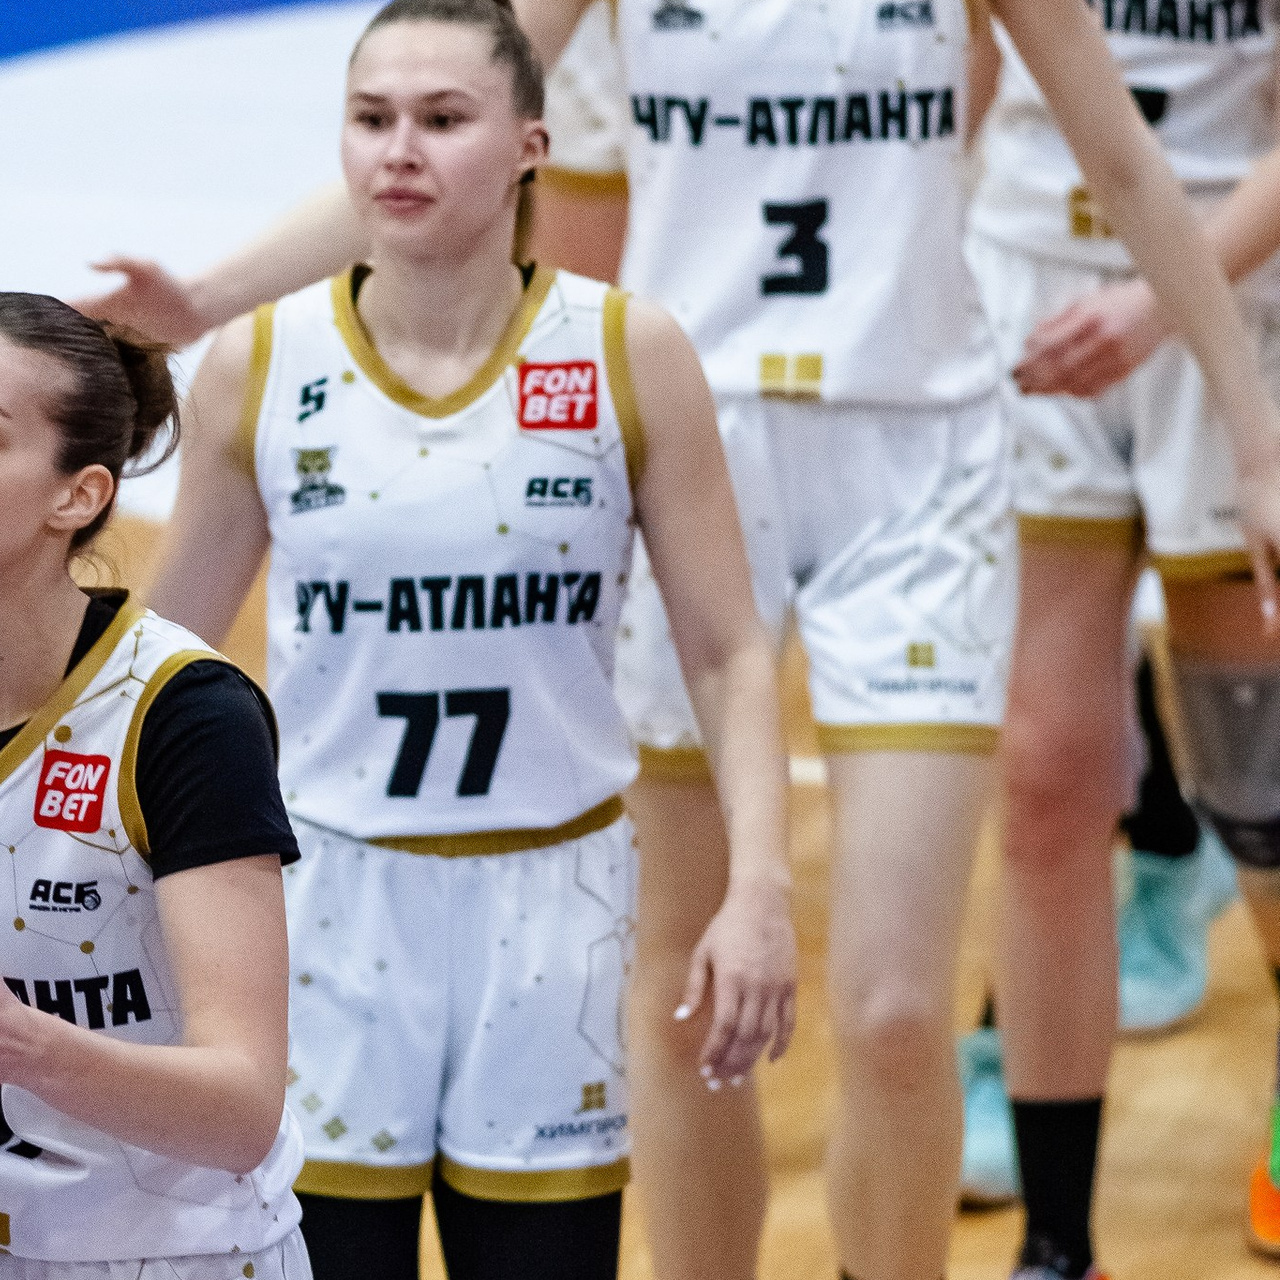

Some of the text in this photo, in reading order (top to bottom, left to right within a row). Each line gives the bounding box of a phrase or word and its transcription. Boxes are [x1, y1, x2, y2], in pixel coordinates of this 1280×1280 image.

[631, 87, 954, 147] ЧГУ-АТЛАНТА
[760, 200, 830, 297] 3
[523, 366, 594, 394] FON
[523, 393, 594, 422] BET
[376, 687, 511, 797] 77
[44, 760, 106, 791] FON
[39, 788, 98, 822] BET
